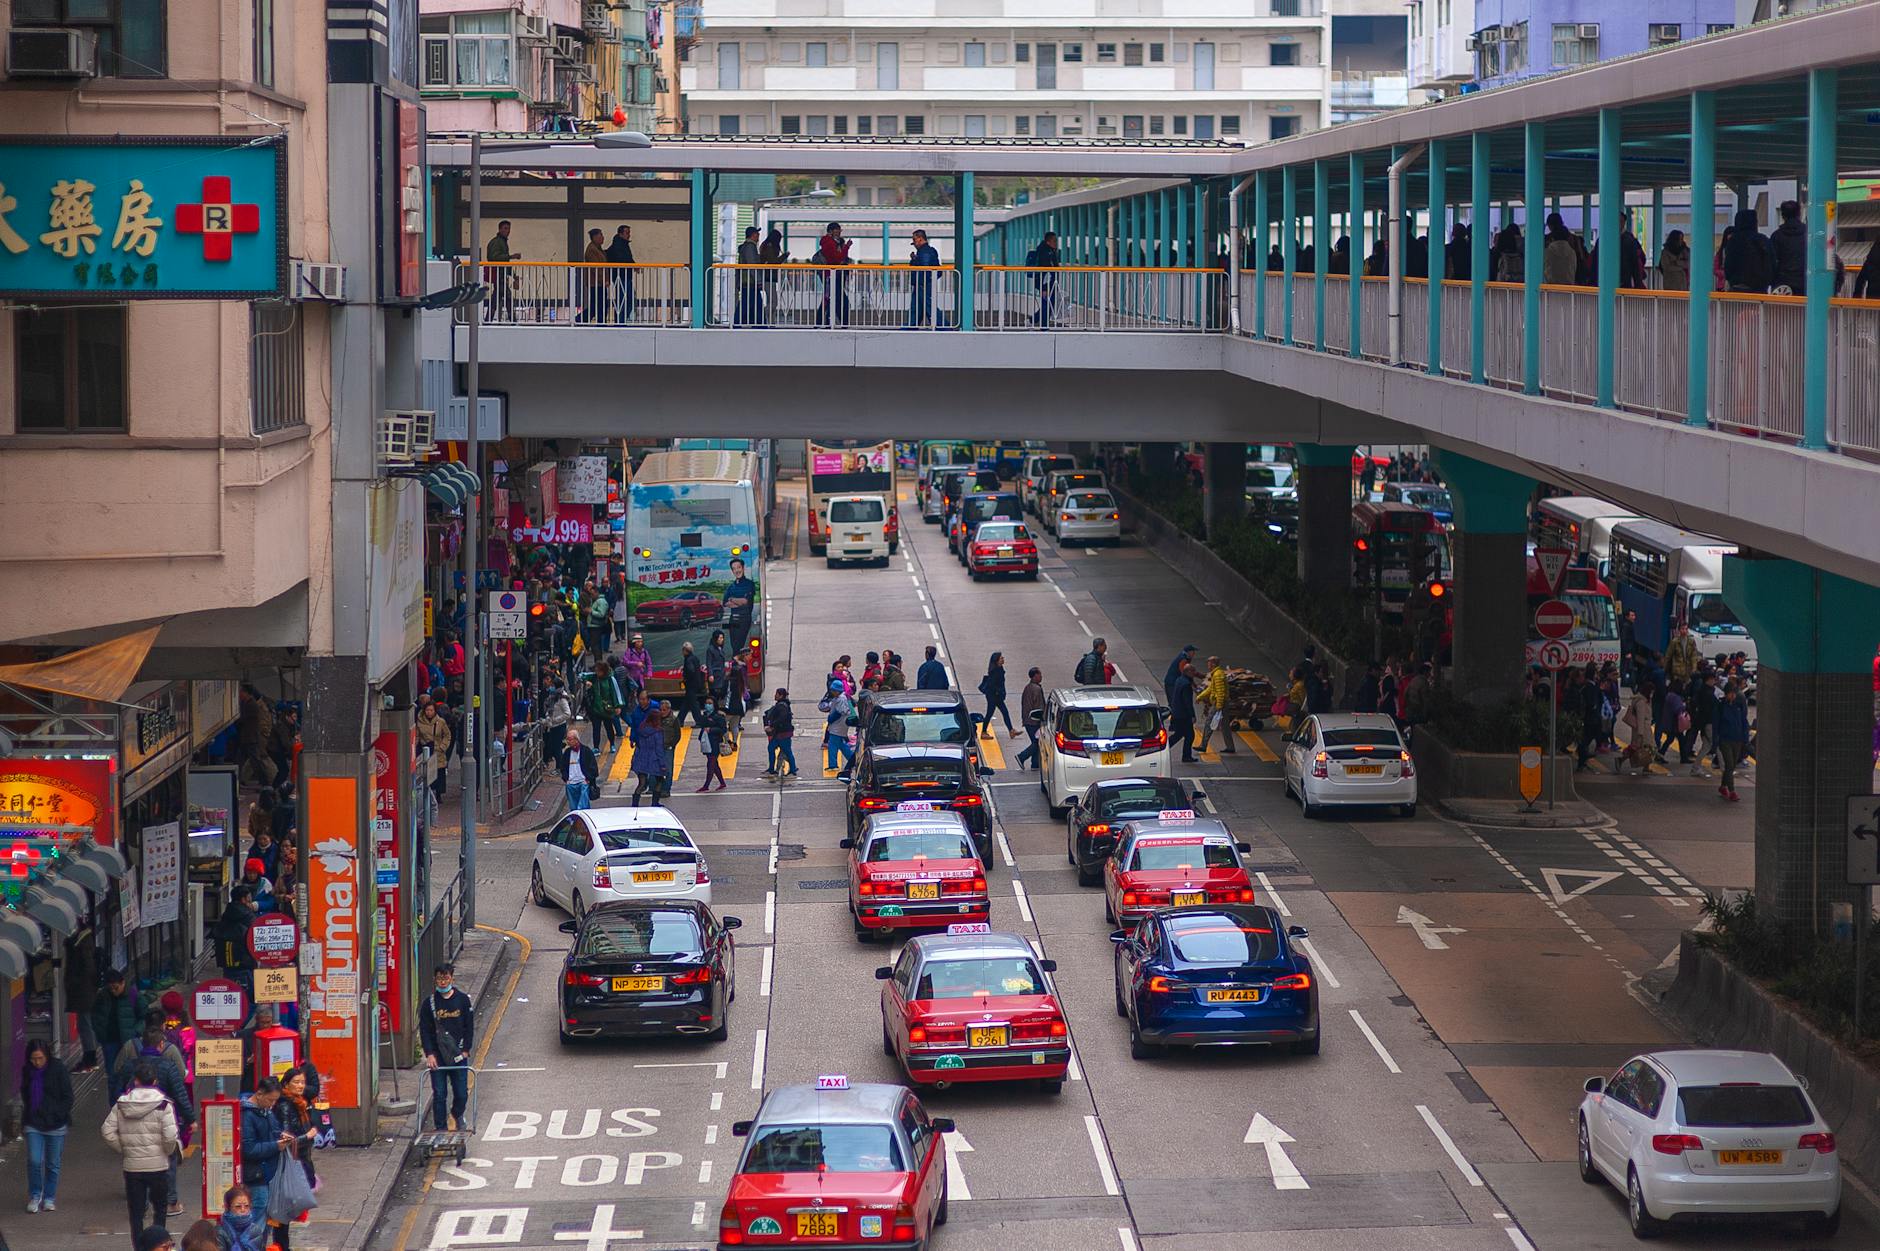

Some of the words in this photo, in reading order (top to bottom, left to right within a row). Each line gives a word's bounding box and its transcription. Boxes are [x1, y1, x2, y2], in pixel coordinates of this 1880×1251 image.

[512, 613, 520, 624] 7
[513, 628, 525, 637] 12
[1572, 652, 1596, 662] 2896
[1598, 652, 1620, 661] 3299
[900, 803, 929, 811] TAXI
[636, 872, 650, 882] AM
[650, 871, 673, 882] 1391
[911, 890, 936, 898] 6709
[951, 924, 987, 933] TAXI
[615, 979, 629, 989] NP
[633, 979, 660, 989] 3783
[1210, 991, 1225, 1001] RU
[1229, 991, 1256, 1001] 4443
[981, 1027, 996, 1037] UF
[976, 1036, 1002, 1046] 9261
[819, 1078, 845, 1087] TAXI
[481, 1107, 661, 1142] BUS
[1722, 1151, 1740, 1163] UW
[1746, 1151, 1780, 1163] 4589
[431, 1151, 683, 1191] STOP
[809, 1213, 824, 1224] KK
[800, 1224, 835, 1236] 7683
